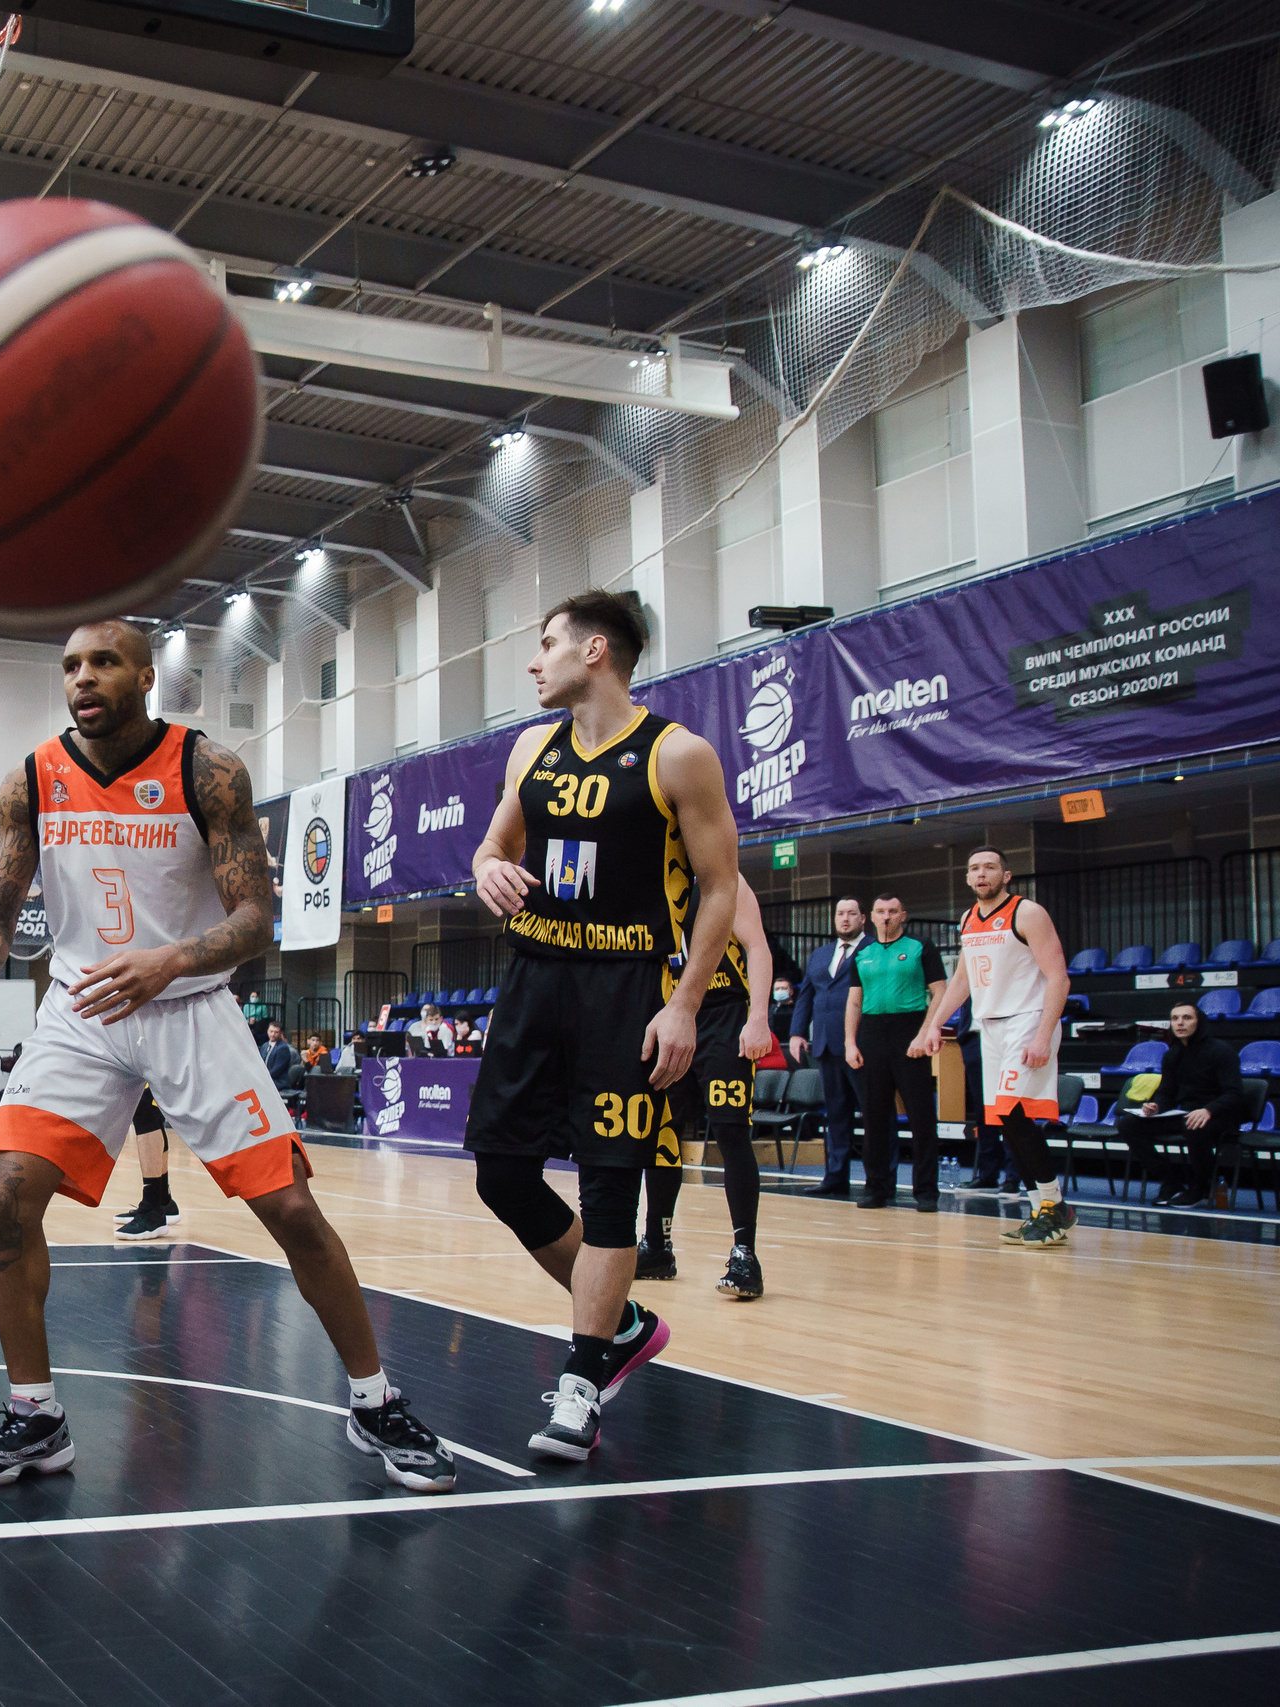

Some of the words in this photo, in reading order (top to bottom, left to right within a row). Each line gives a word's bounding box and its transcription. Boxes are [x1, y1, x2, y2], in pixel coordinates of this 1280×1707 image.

[1103, 605, 1136, 626] XXX
[1024, 649, 1061, 671] BWIN
[1063, 624, 1157, 660] ЧЕМПИОНАТ
[1159, 606, 1230, 638] РОССИИ
[751, 655, 786, 689] bwin
[1029, 670, 1077, 693] СРЕДИ
[1078, 651, 1152, 682] МУЖСКИХ
[1154, 634, 1226, 664] КОМАНД
[850, 674, 949, 721] molten
[1069, 684, 1119, 707] СЕЗОН
[1121, 670, 1179, 697] 2020/21
[846, 724, 869, 741] For
[868, 719, 888, 736] the
[888, 711, 914, 731] real
[912, 709, 950, 731] game
[736, 739, 807, 805] СУПЕР
[547, 773, 610, 818] 30
[752, 780, 793, 820] ЛИГА
[417, 798, 465, 834] bwin
[42, 819, 180, 849] БУРЕВЕСТНИК
[363, 834, 398, 878] СУПЕР
[92, 868, 135, 945] 3
[304, 888, 330, 912] РФБ
[15, 922, 46, 937] РОД
[585, 922, 654, 951] ОБЛАСТЬ
[971, 955, 993, 988] 12
[419, 1084, 451, 1101] molten
[709, 1079, 747, 1107] 63
[998, 1070, 1019, 1091] 12
[234, 1088, 271, 1137] 3
[375, 1100, 405, 1126] СУПЕР
[593, 1092, 654, 1139] 30
